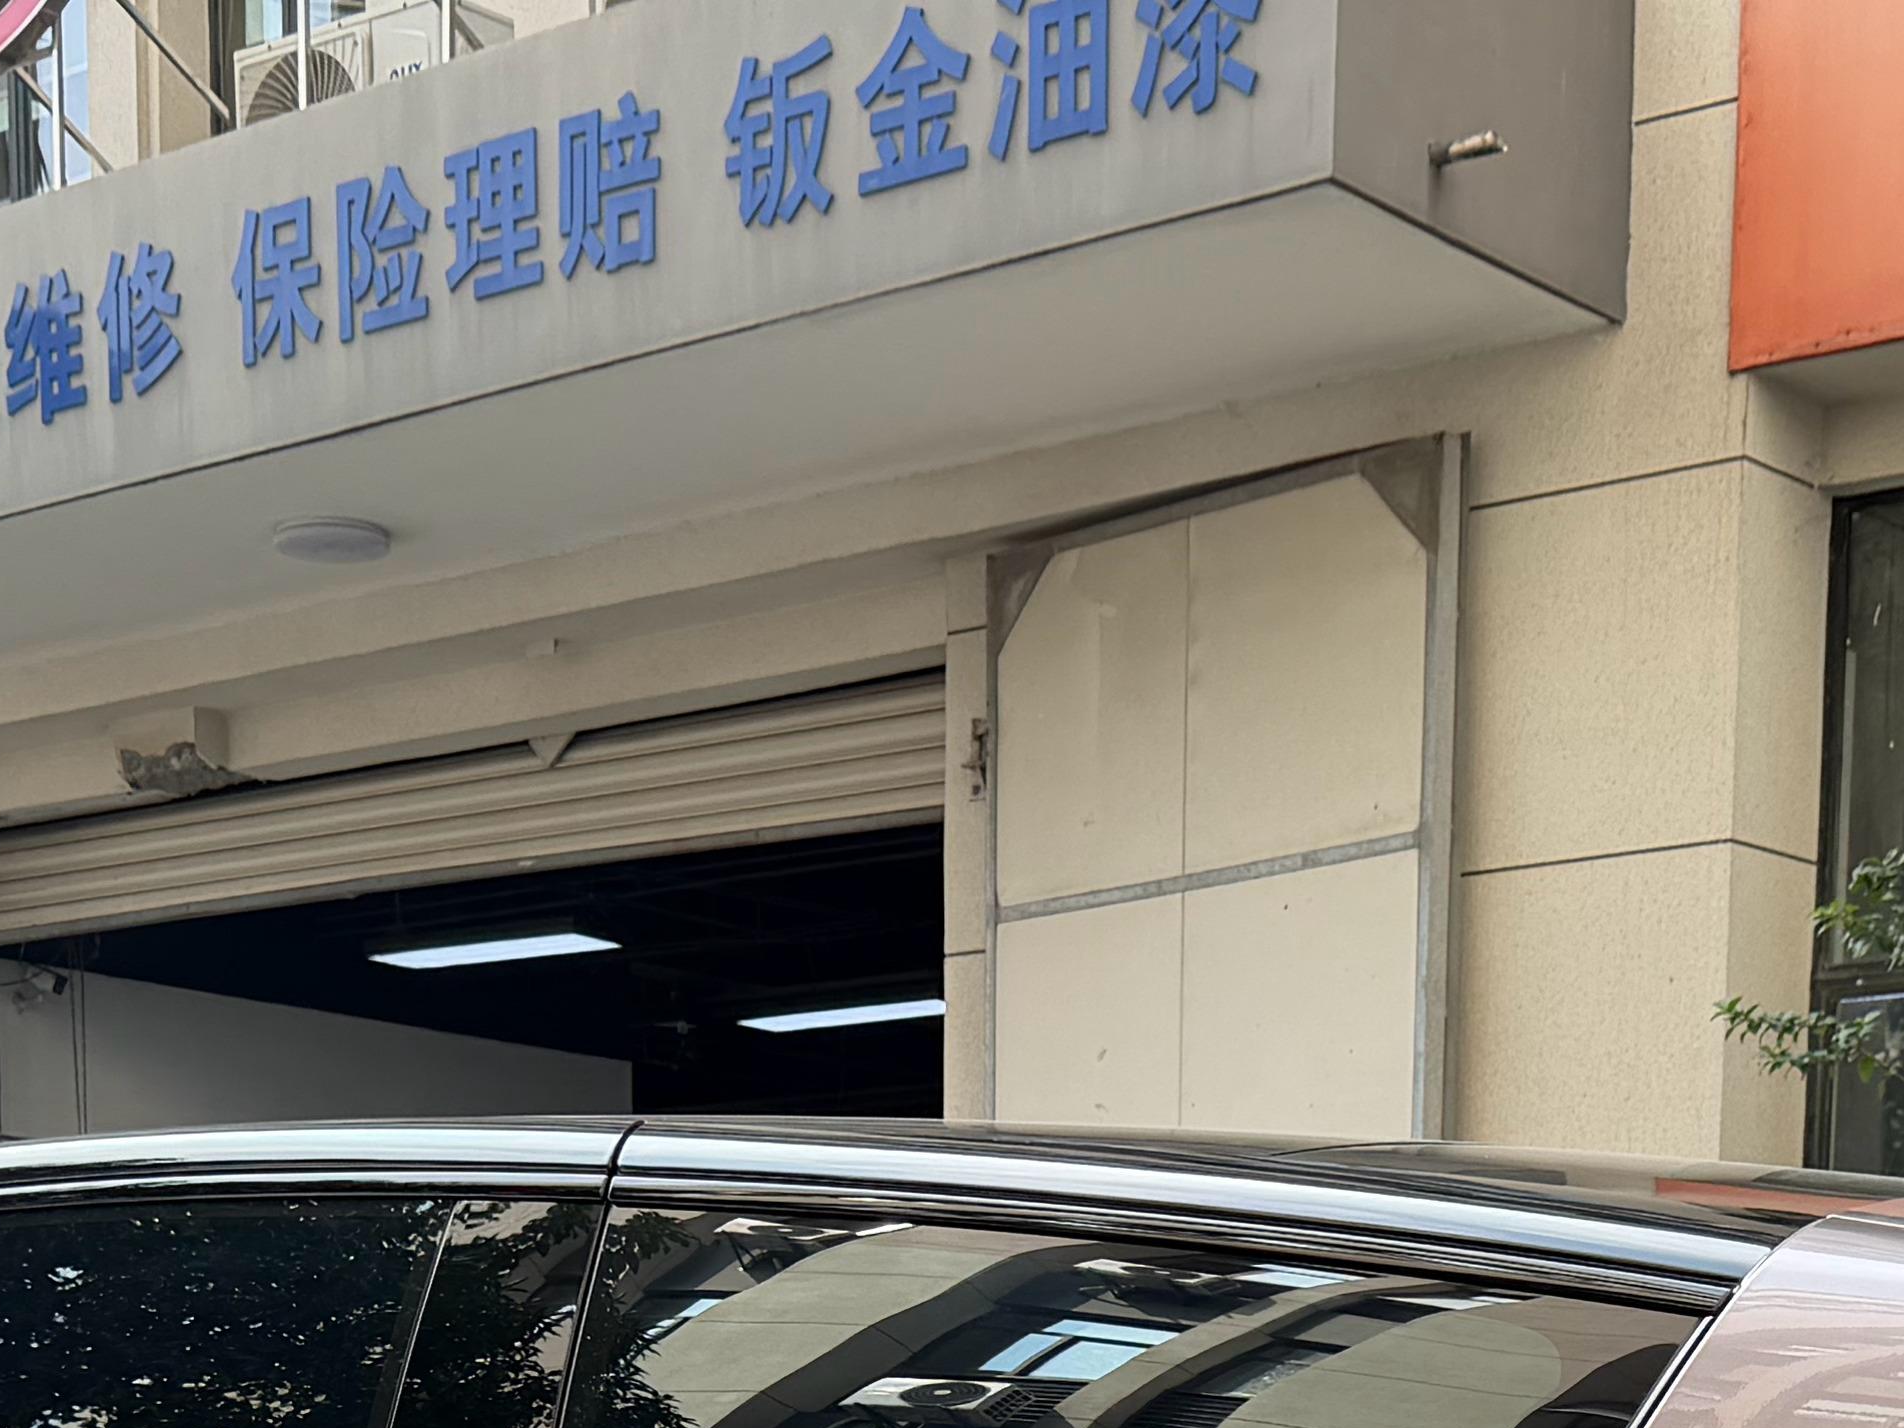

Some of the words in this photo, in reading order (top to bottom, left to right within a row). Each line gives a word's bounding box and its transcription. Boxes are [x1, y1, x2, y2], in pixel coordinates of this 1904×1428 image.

[230, 91, 663, 367] 保险理赔
[724, 0, 1259, 227] 钣金油漆
